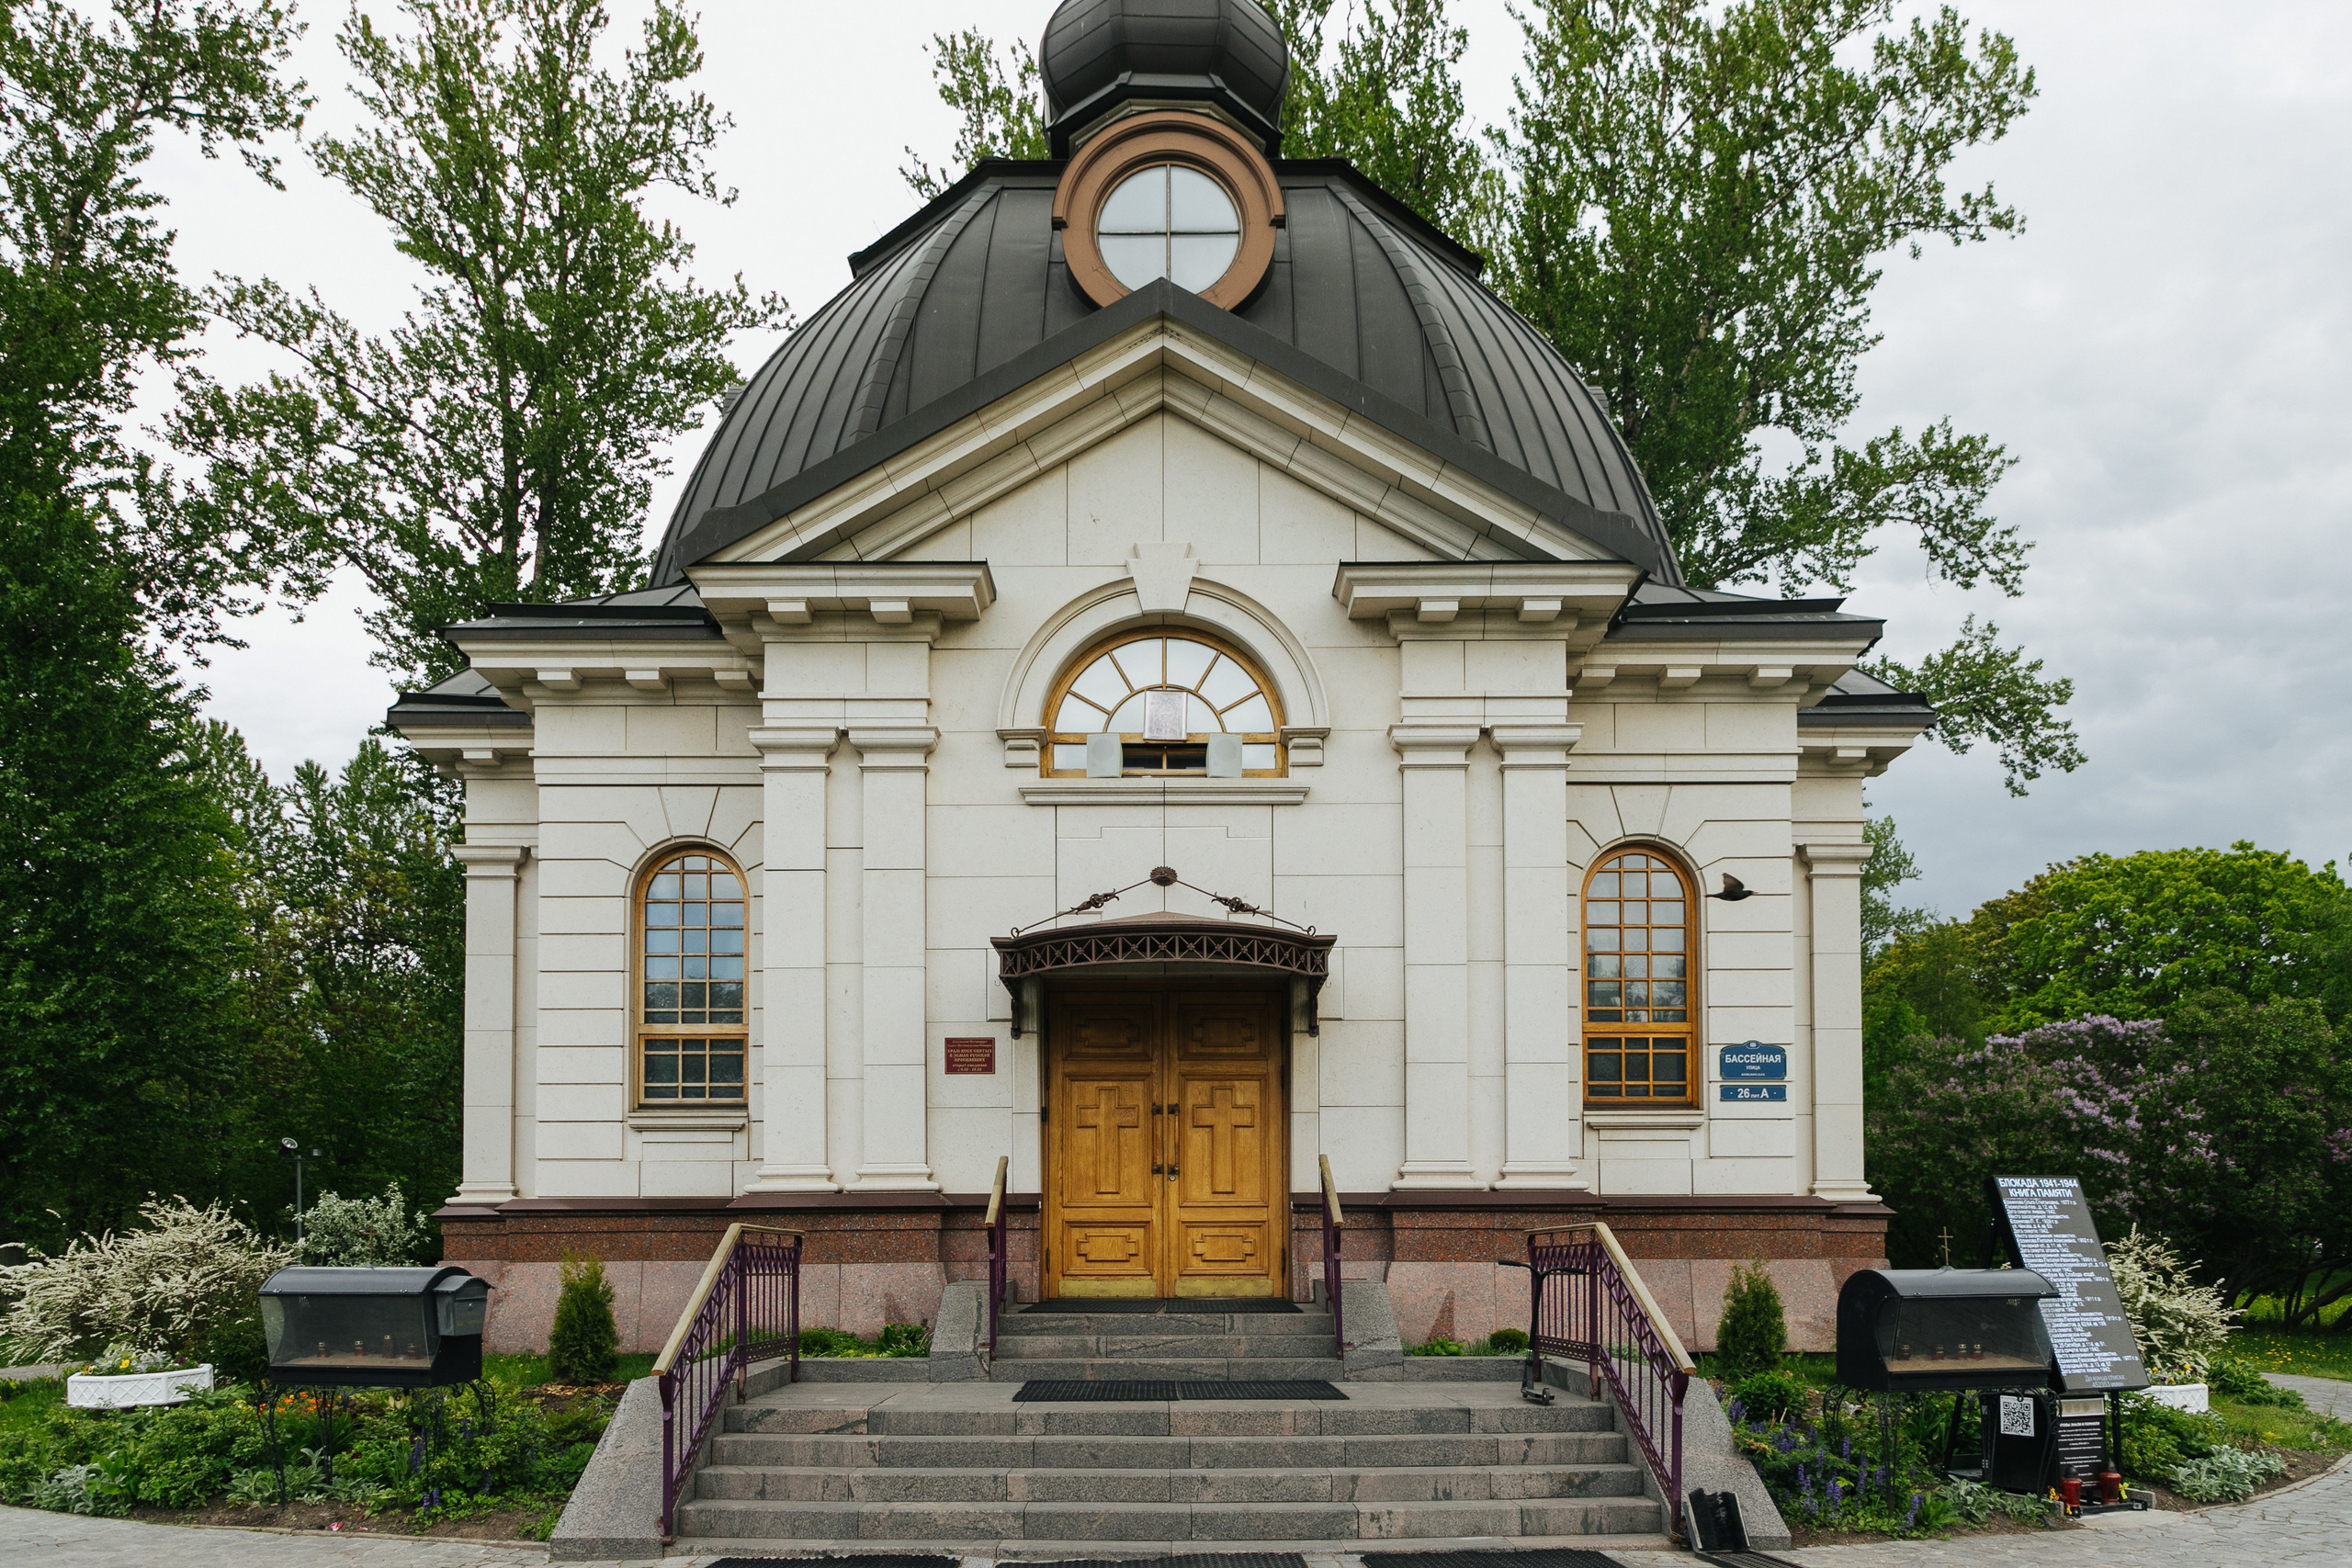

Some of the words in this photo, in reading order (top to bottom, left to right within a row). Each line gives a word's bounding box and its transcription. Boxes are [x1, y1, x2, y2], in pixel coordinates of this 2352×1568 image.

[1725, 1052, 1781, 1063] БАССЕЙНАЯ
[1737, 1088, 1750, 1098] 26
[1998, 1179, 2039, 1188] БЛОКАДА
[2039, 1179, 2078, 1188] 1941-1944
[2008, 1189, 2036, 1197] КНИГА
[2036, 1189, 2073, 1197] ПАМЯТИ
